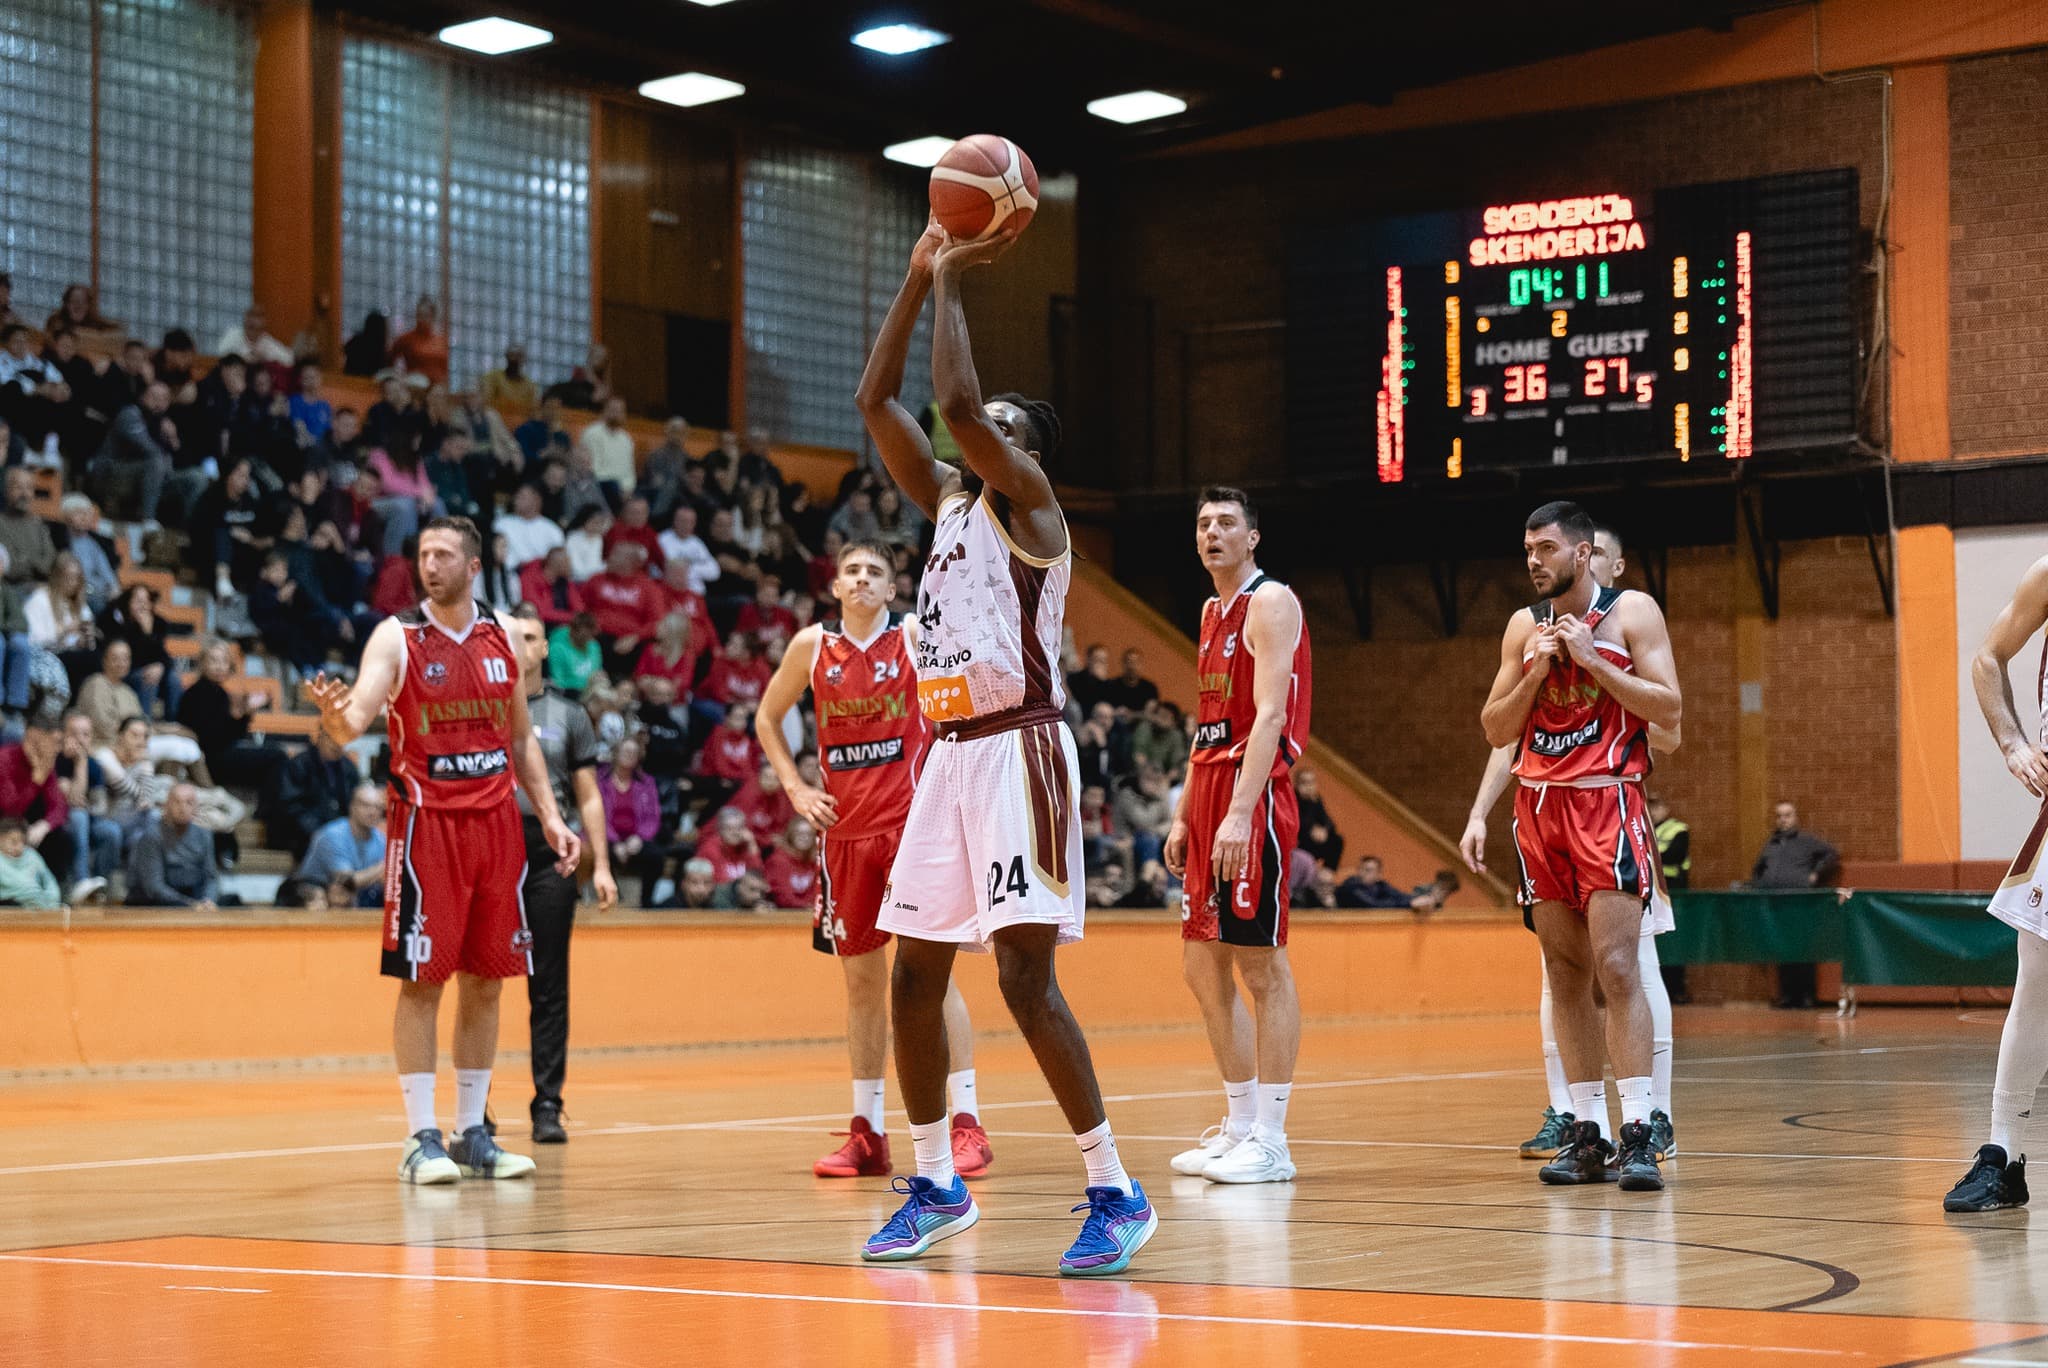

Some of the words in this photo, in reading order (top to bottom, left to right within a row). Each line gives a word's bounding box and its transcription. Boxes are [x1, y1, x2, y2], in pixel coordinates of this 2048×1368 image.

[1469, 222, 1646, 266] SKENDERIJA
[1509, 261, 1609, 306] 04:11
[1551, 309, 1568, 337] 2
[1475, 338, 1551, 366] HOME
[1567, 329, 1650, 358] GUEST
[1504, 363, 1547, 402] 36
[1584, 357, 1628, 396] 27
[1636, 375, 1652, 402] 5
[1471, 388, 1487, 416] 3
[1223, 632, 1238, 658] 5
[482, 657, 508, 683] 10
[874, 659, 900, 683] 24
[991, 855, 1029, 906] 24
[1182, 894, 1191, 921] 5
[822, 916, 847, 940] 24
[405, 933, 432, 963] 10
